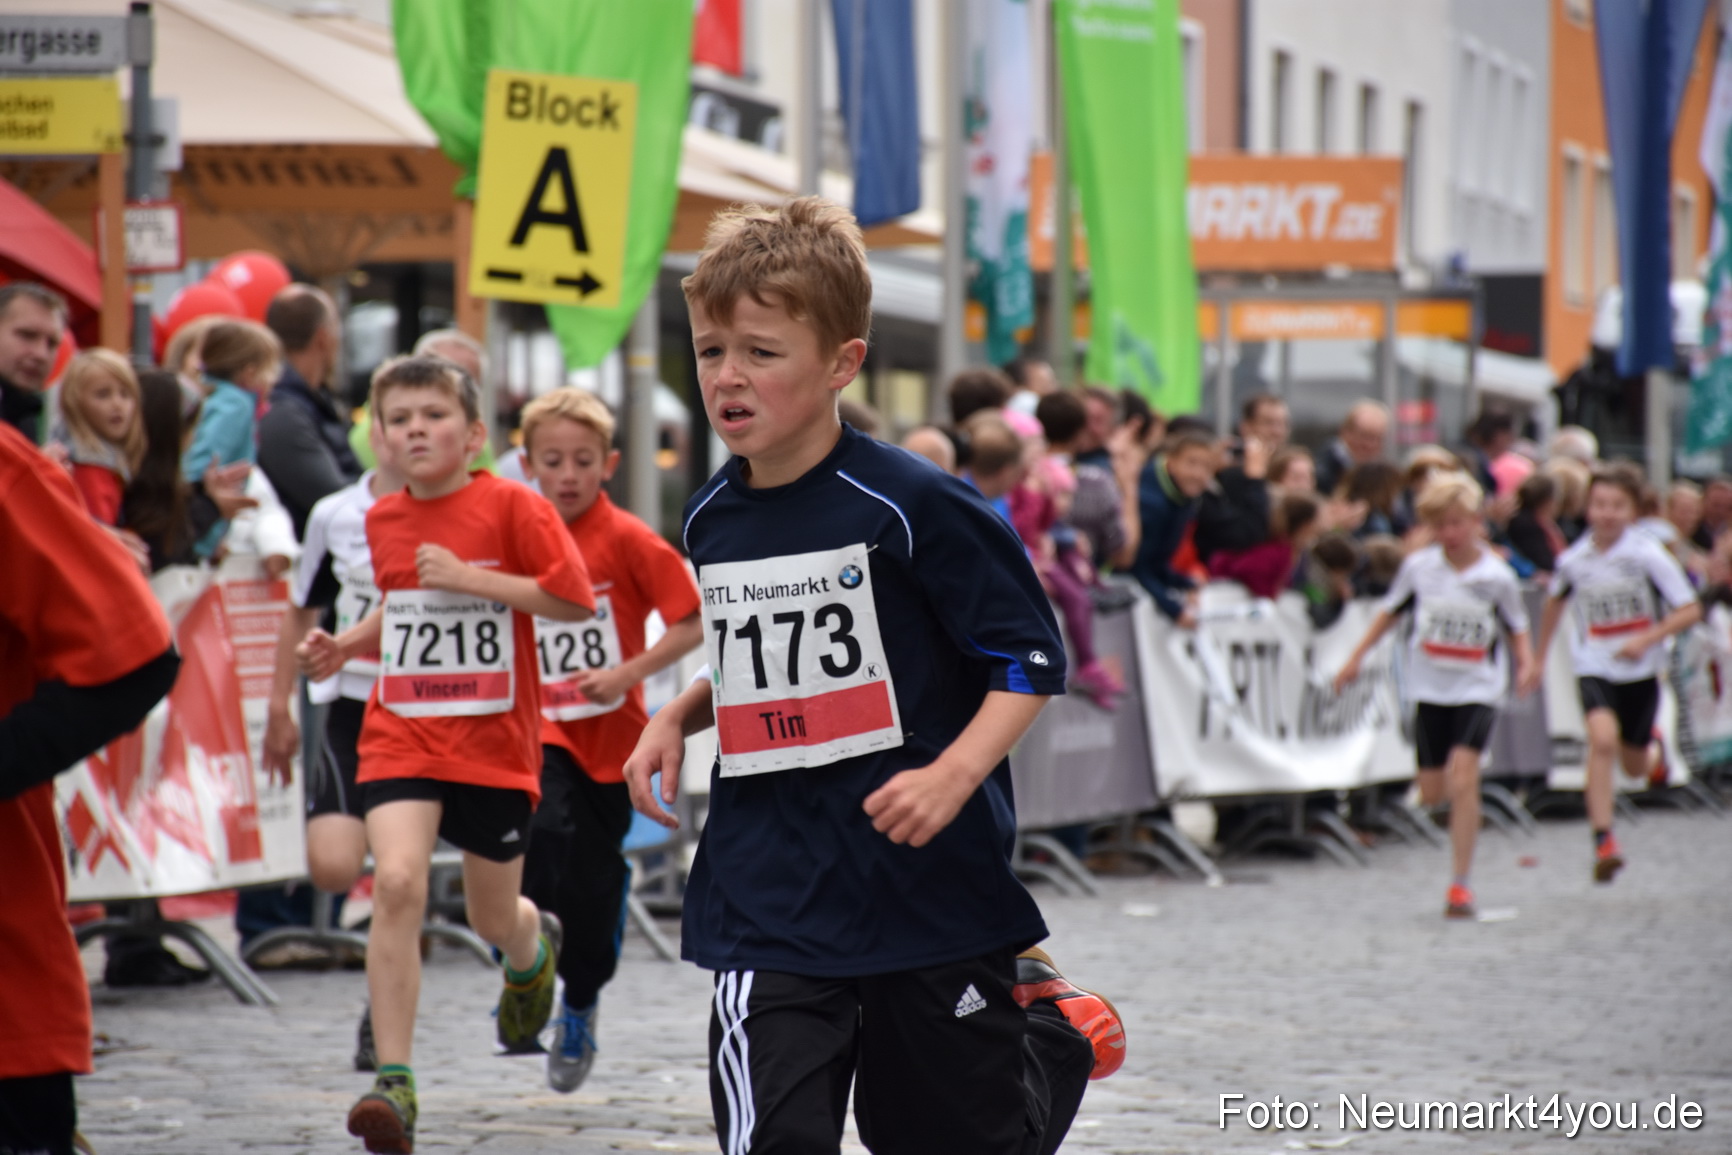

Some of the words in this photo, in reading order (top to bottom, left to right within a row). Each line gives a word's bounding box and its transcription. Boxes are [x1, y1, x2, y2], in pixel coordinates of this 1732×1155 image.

[506, 80, 622, 131] Block
[508, 145, 590, 255] A
[743, 576, 830, 603] Neumarkt
[423, 602, 487, 614] Neumarkt
[395, 619, 500, 668] 7218
[711, 602, 862, 690] 7173
[867, 664, 877, 679] K
[412, 680, 479, 699] Vincent
[759, 710, 808, 741] Tim
[954, 998, 987, 1018] adidas
